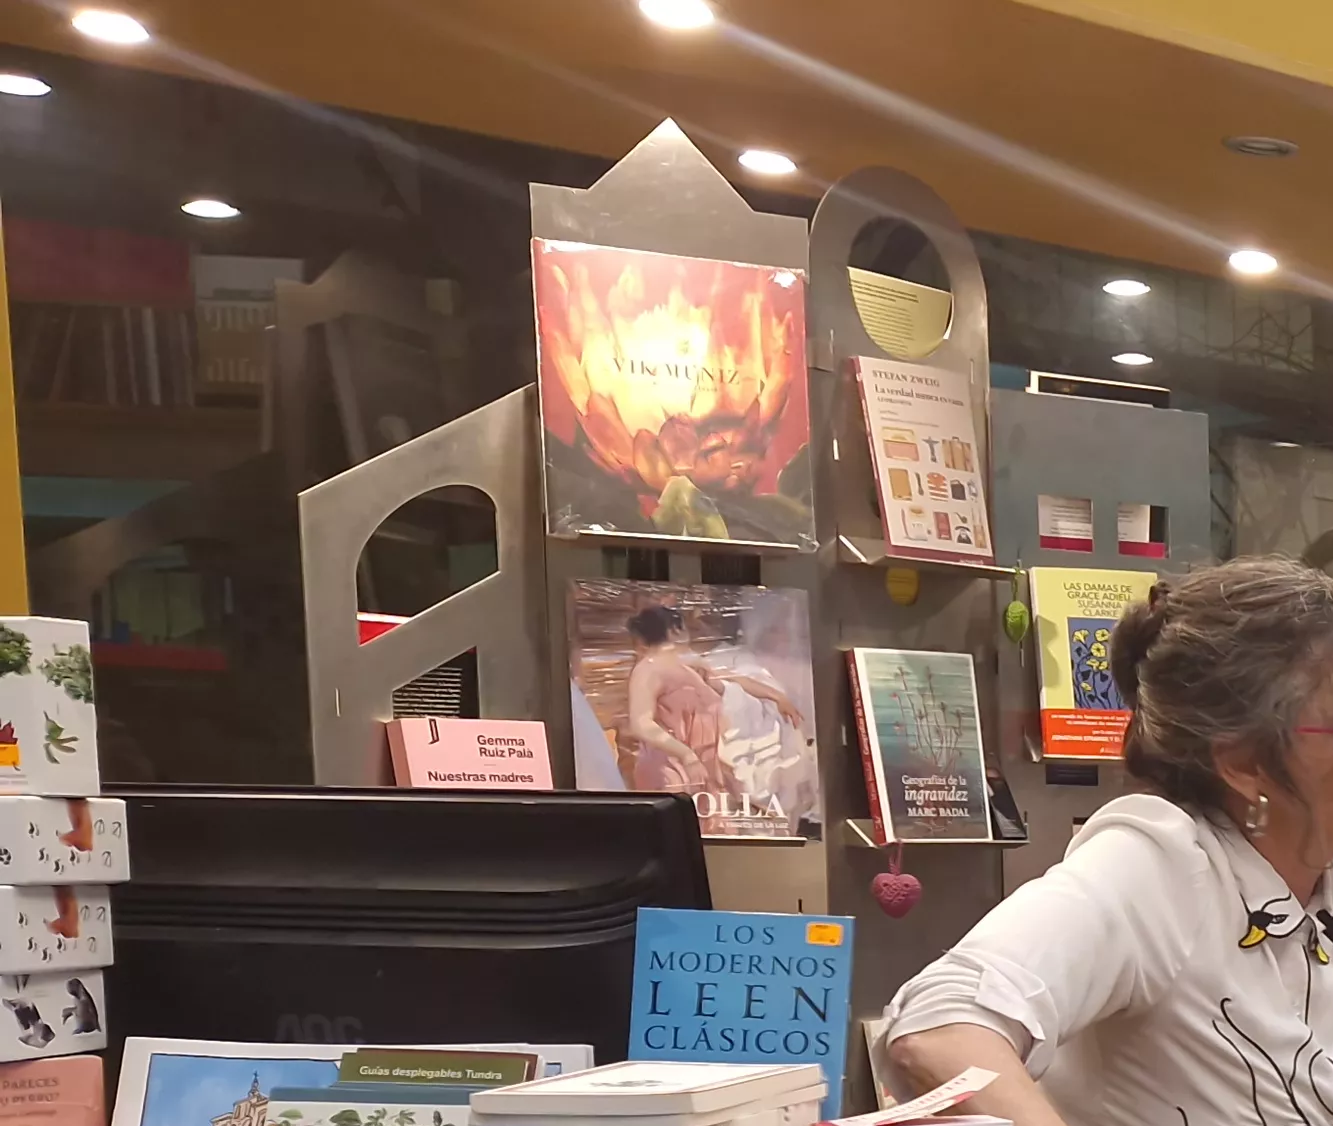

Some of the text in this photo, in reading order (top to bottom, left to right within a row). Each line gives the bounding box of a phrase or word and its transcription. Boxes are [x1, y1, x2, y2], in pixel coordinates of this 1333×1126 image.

[614, 358, 740, 386] VIK MUNIZ
[872, 370, 940, 387] STEFAN ZWEIG
[875, 384, 914, 397] La verdad
[1084, 584, 1118, 592] DAMAS
[1121, 585, 1132, 593] DE
[1068, 591, 1130, 602] GRACE ADIEU
[1078, 600, 1122, 609] SUSANNA
[1083, 608, 1118, 617] CLARKE
[477, 735, 525, 747] Gemma
[479, 747, 504, 758] Ruiz
[428, 770, 534, 784] Nuestras madres
[902, 774, 967, 787] Geografías de la
[905, 786, 968, 806] ingravidez
[693, 792, 787, 818] OLLA
[908, 807, 970, 817] MARC BADAL
[715, 924, 775, 945] LOS
[649, 950, 837, 979] MODERNOS
[648, 980, 833, 1022] LEEN
[643, 1021, 830, 1056] CLÁSICOS
[359, 1064, 502, 1080] Guías desplegables Tundra
[3, 1077, 59, 1090] PARECES
